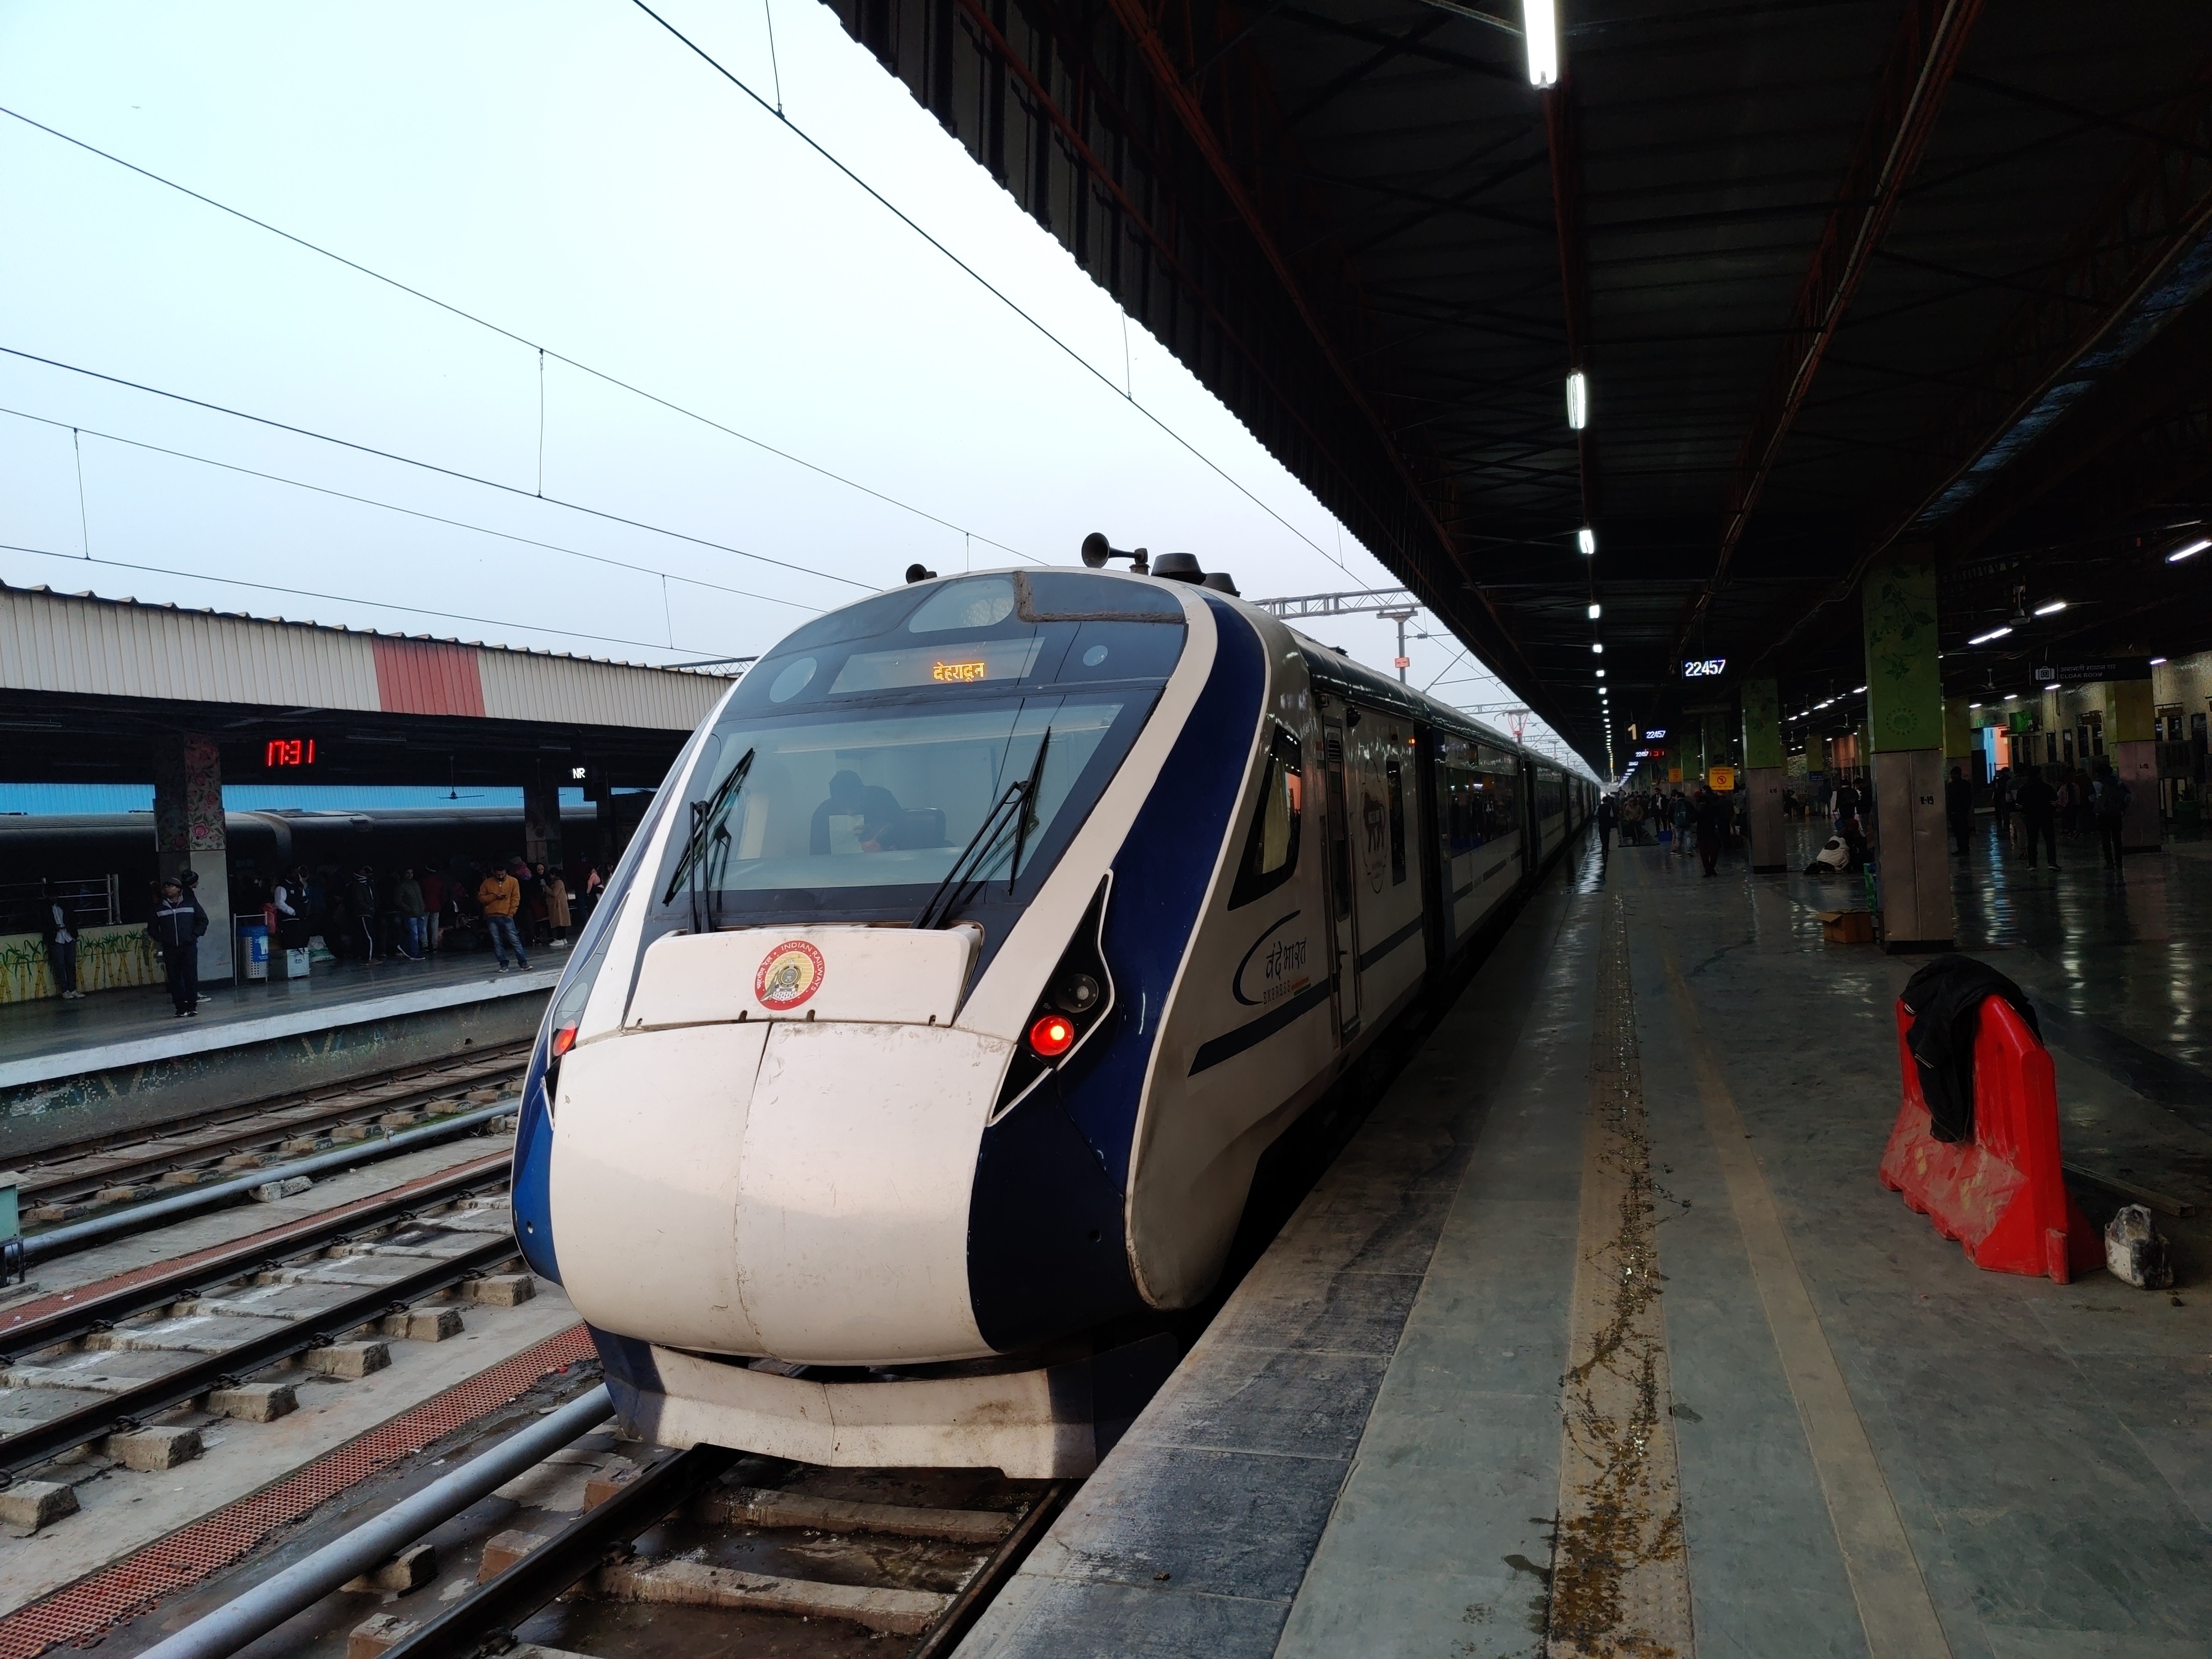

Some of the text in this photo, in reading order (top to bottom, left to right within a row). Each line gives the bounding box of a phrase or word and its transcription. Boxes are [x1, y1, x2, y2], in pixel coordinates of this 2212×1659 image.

[933, 661, 985, 682] देहरादून
[1685, 659, 1726, 676] 22457
[1628, 724, 1637, 740] 1
[1646, 730, 1666, 738] 22457
[268, 739, 314, 766] 17:31
[572, 768, 586, 779] NR
[1920, 796, 1934, 805] R-19
[761, 956, 772, 966] रेल
[781, 942, 823, 991] INDIAN RAILWAYS
[1264, 980, 1290, 1004] EXPRESS
